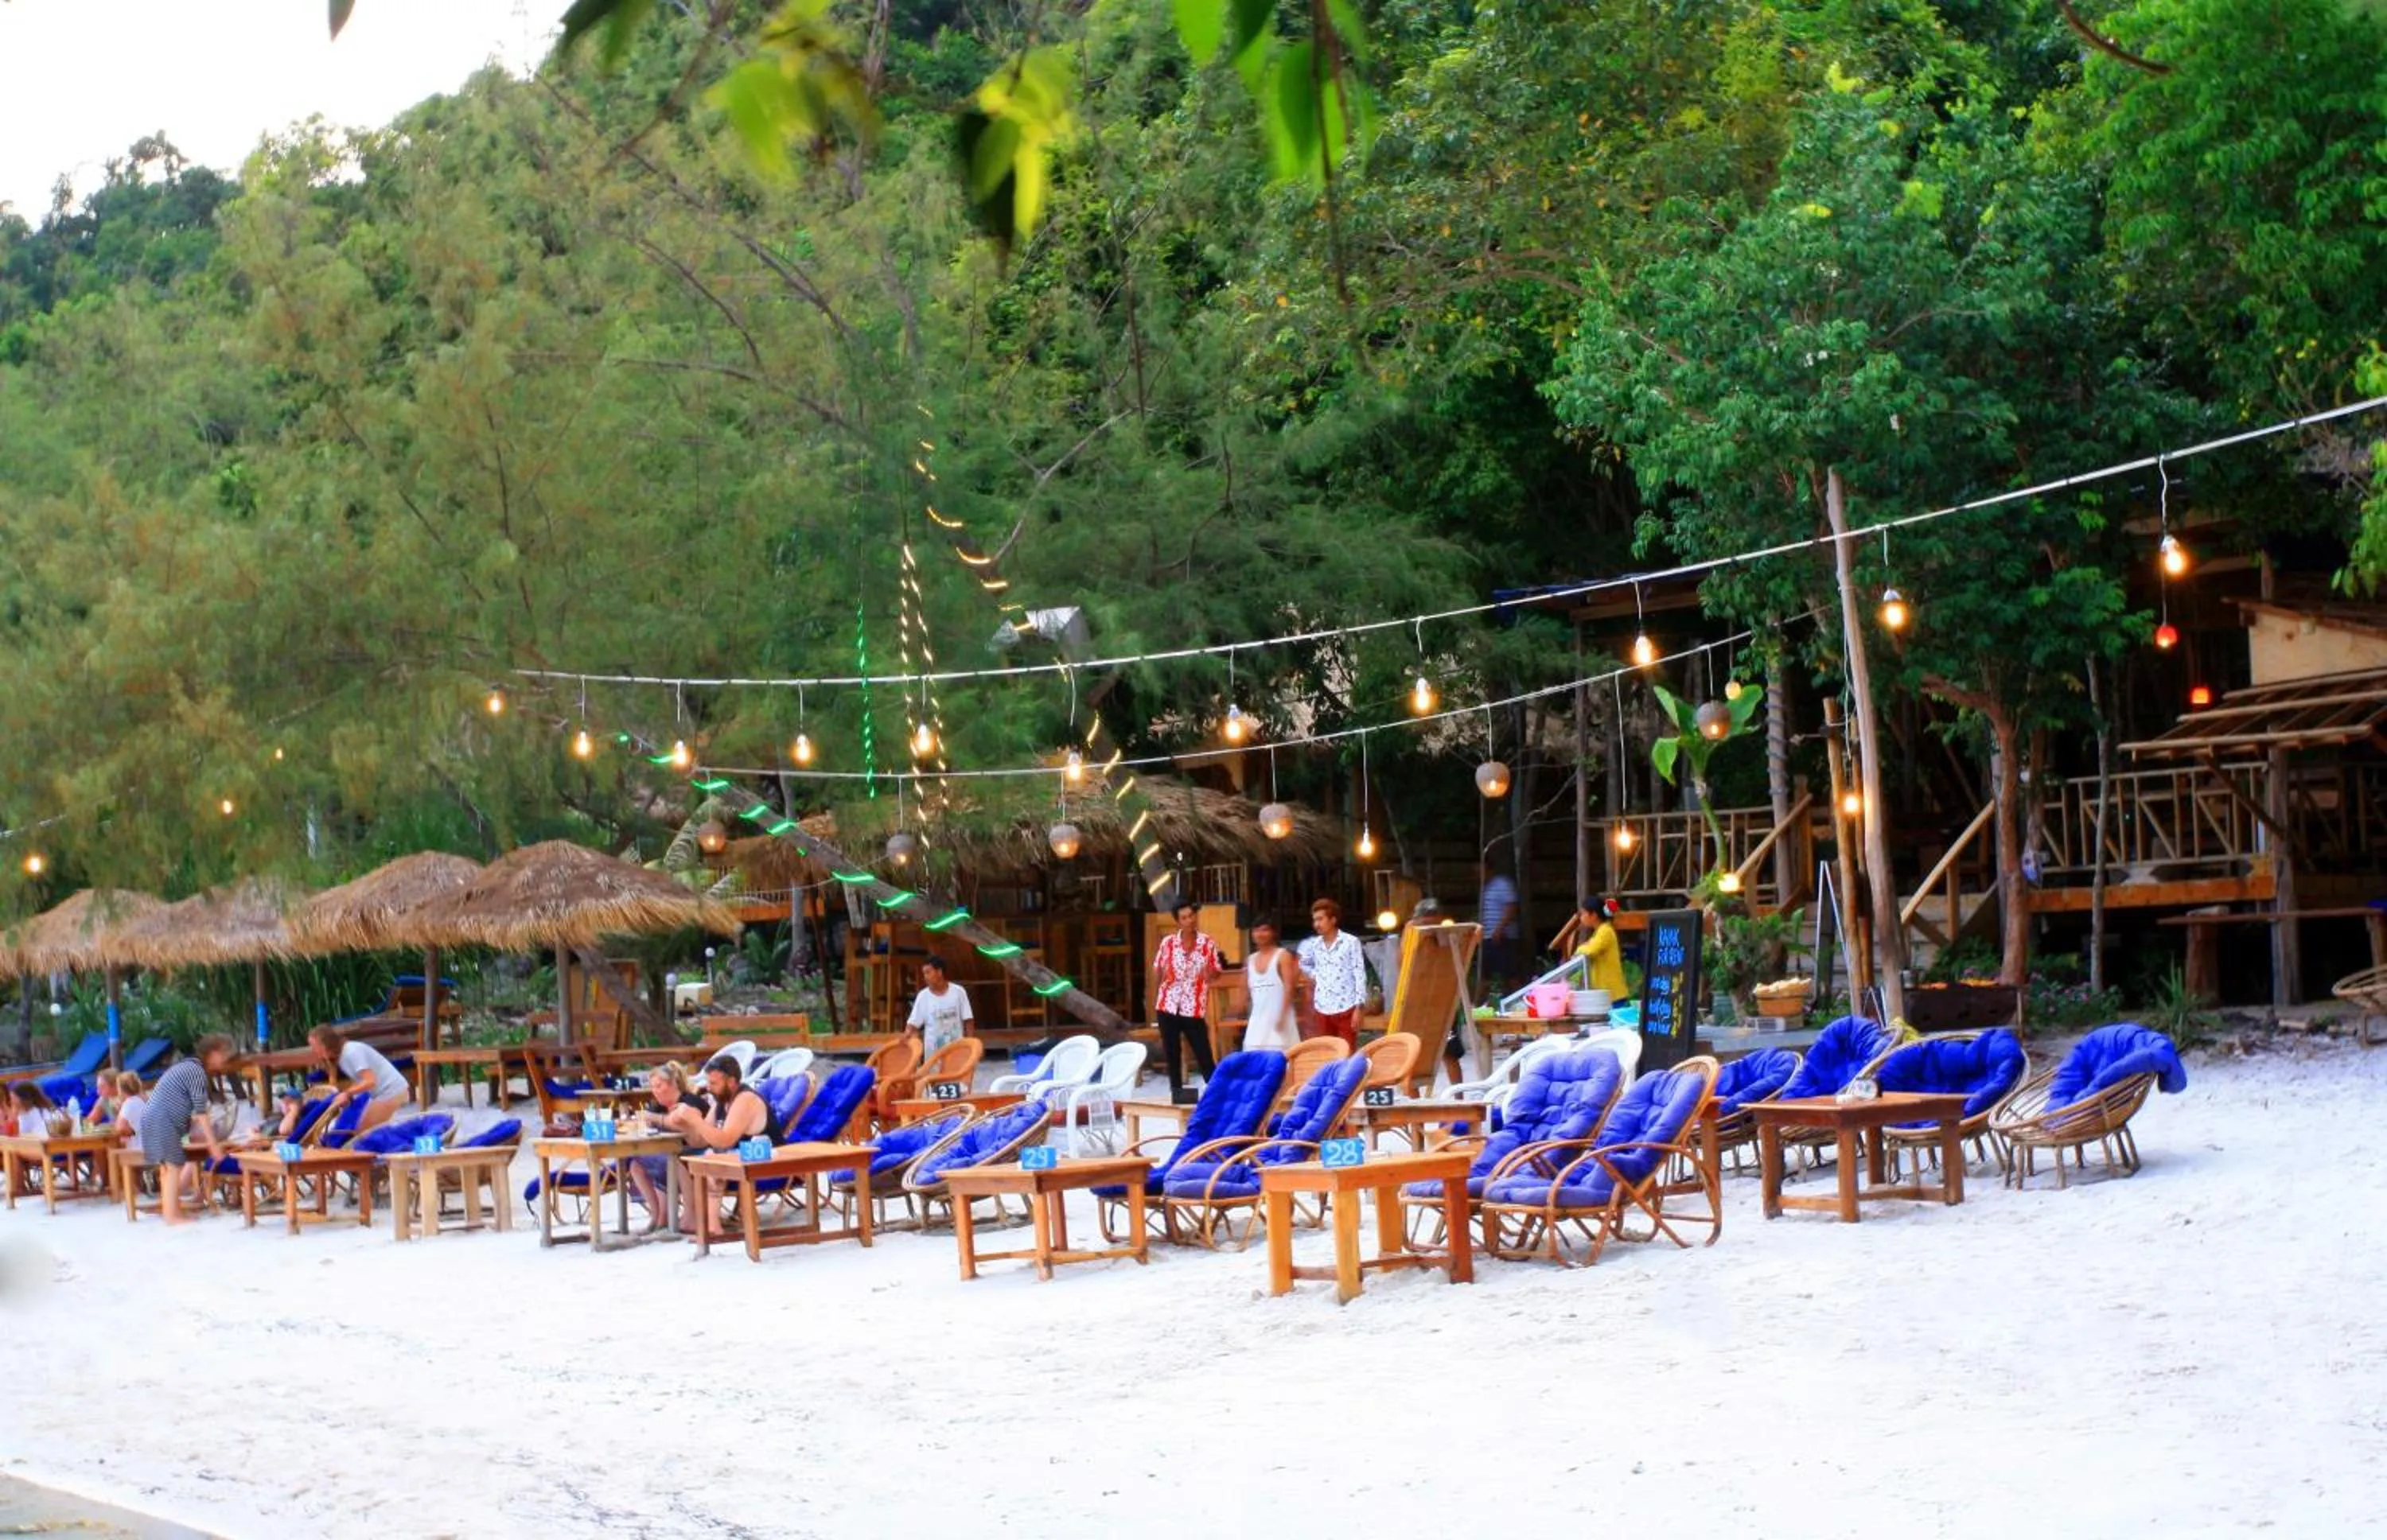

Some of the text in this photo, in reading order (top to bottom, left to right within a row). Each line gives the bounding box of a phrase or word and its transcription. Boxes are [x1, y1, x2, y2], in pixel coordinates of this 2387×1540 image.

[939, 1085, 957, 1098] 23
[1369, 1091, 1389, 1105] 25
[590, 1122, 608, 1139] 31
[743, 1142, 765, 1159] 30
[1024, 1147, 1048, 1168] 29
[1326, 1141, 1357, 1165] 28
